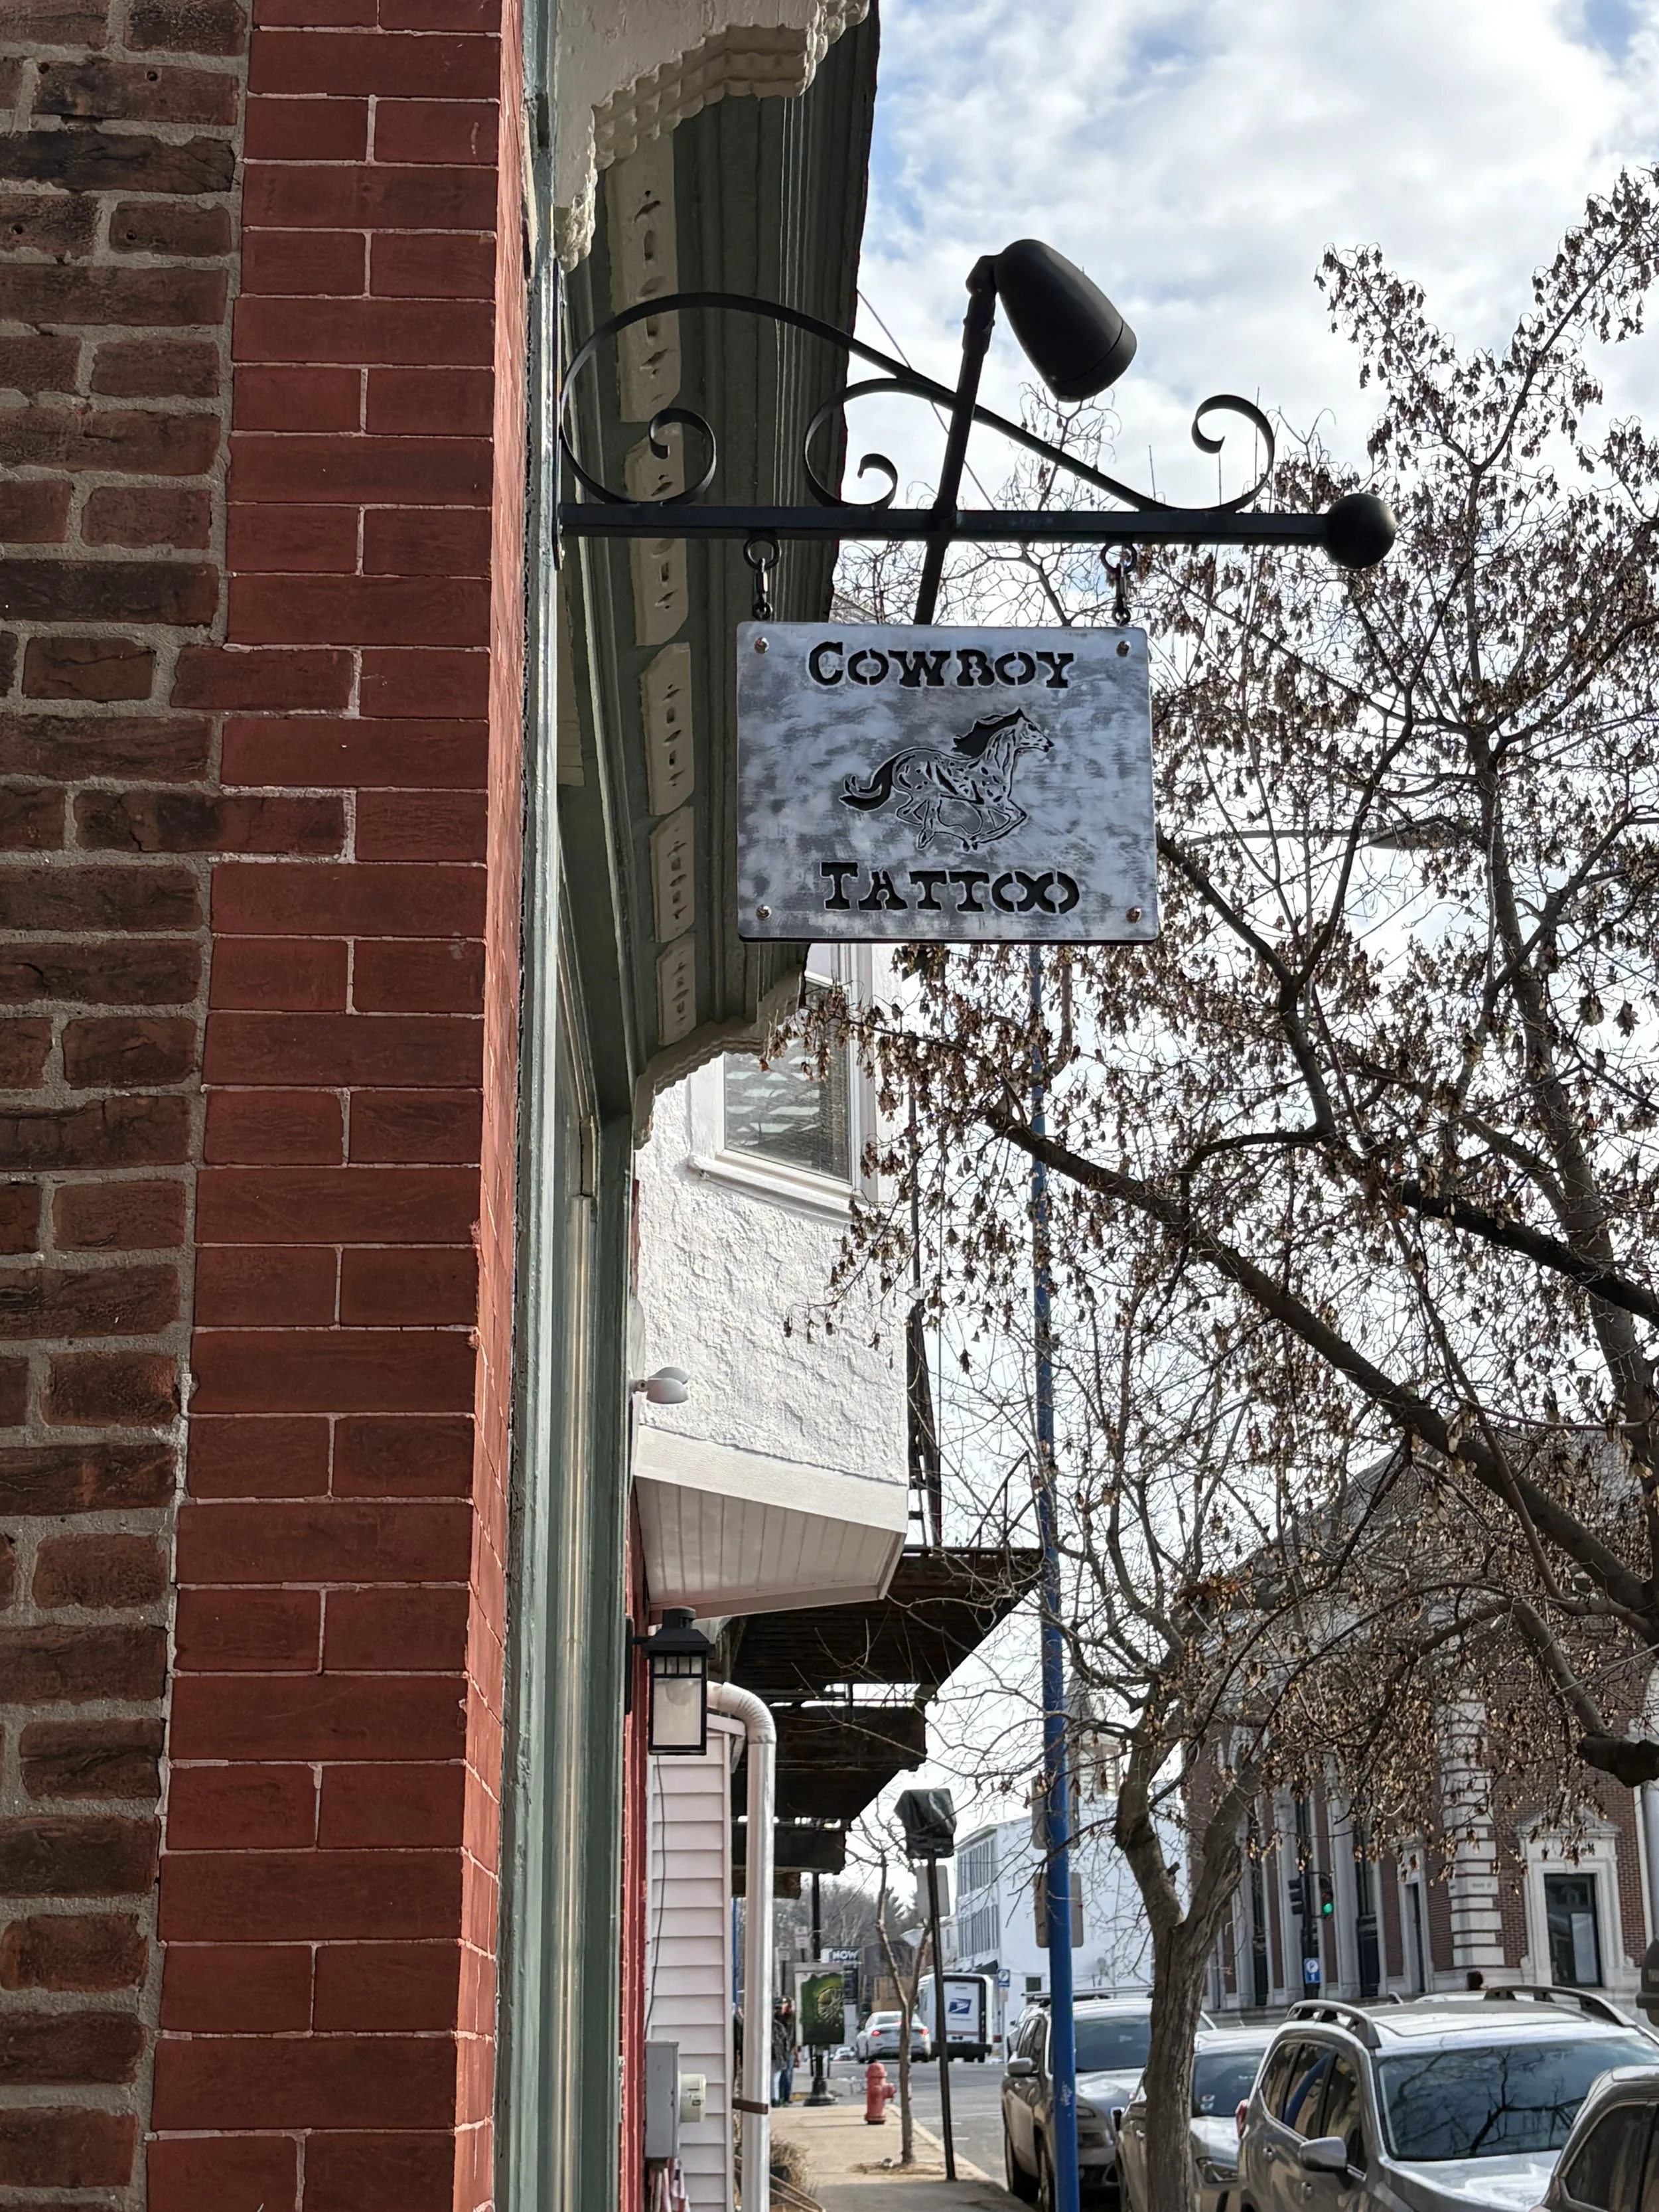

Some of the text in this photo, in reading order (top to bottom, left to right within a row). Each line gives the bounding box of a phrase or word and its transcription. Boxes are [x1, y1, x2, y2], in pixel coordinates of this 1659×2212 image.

[809, 642, 1074, 688] COWBOY
[821, 862, 1080, 913] TATTOO
[833, 1950, 858, 1959] NOW
